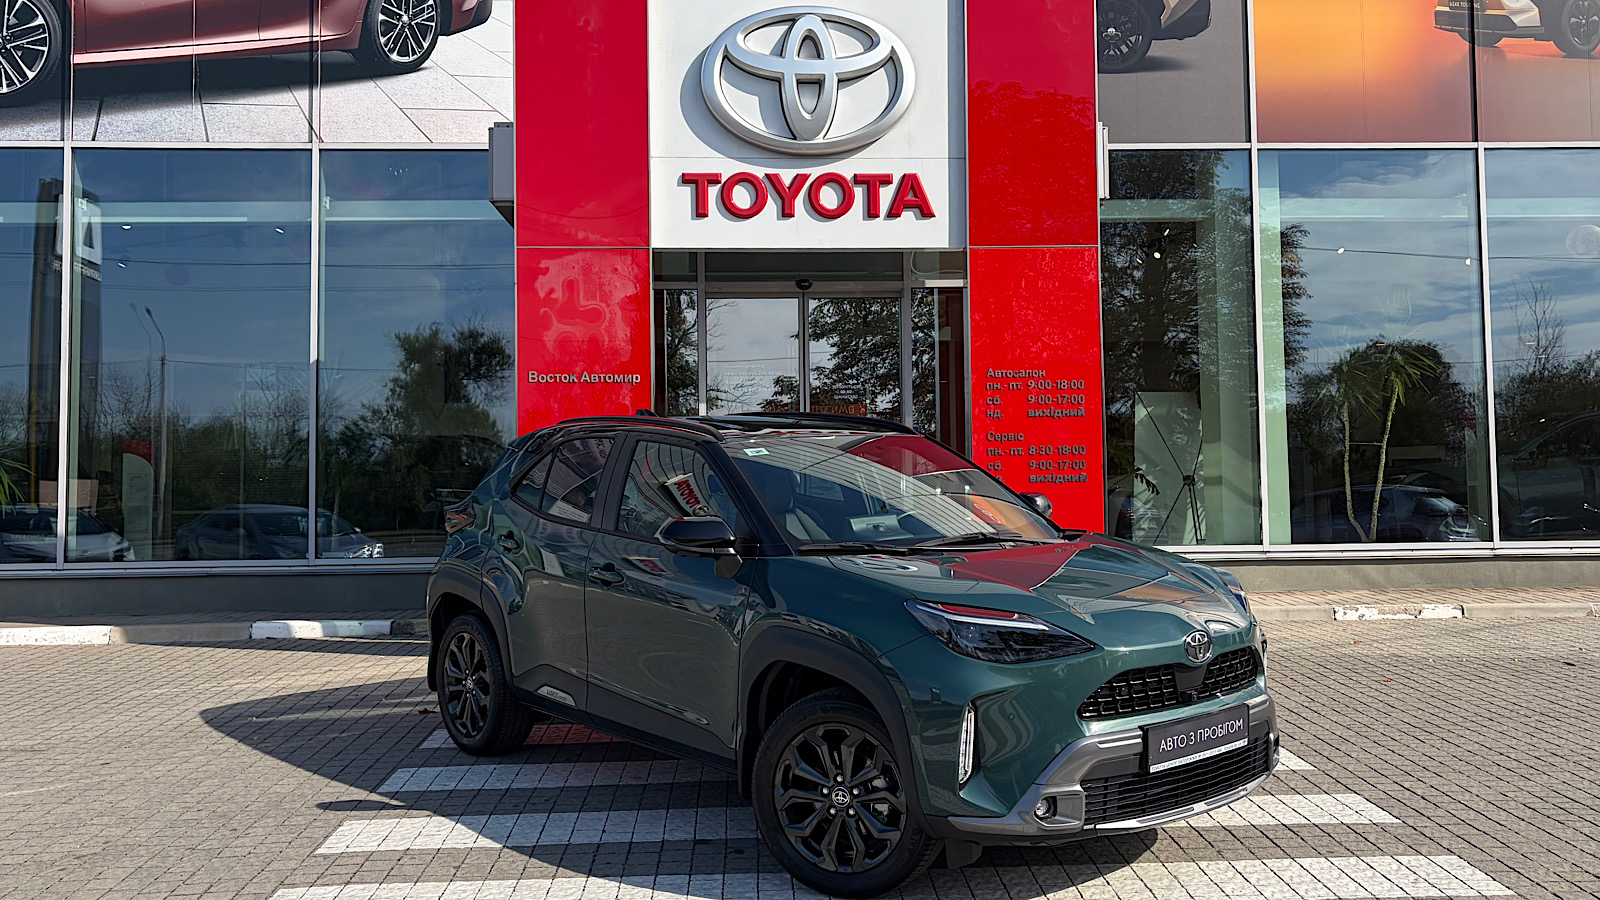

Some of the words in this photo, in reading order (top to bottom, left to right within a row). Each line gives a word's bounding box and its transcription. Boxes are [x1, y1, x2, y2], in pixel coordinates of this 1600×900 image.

[681, 171, 936, 220] TOYOTA
[528, 370, 578, 383] Восток
[580, 370, 641, 385] Автомир
[986, 368, 1046, 378] Автосалон
[1027, 379, 1085, 390] 9:00-18:00
[986, 395, 1003, 406] сб.
[1027, 394, 1086, 405] 9:00-17:00
[986, 409, 1004, 419] нд.
[1027, 406, 1086, 419] вихідний
[987, 431, 1024, 443] Сервіс
[1028, 445, 1087, 456] 8:30-18:00
[987, 461, 1005, 471] сб.
[1028, 460, 1087, 471] 9:00-17:00
[1028, 472, 1088, 485] вихідний
[1159, 735, 1187, 752] АВТО
[1188, 731, 1195, 745] З
[1197, 718, 1244, 742] ПРОБІГОМ
